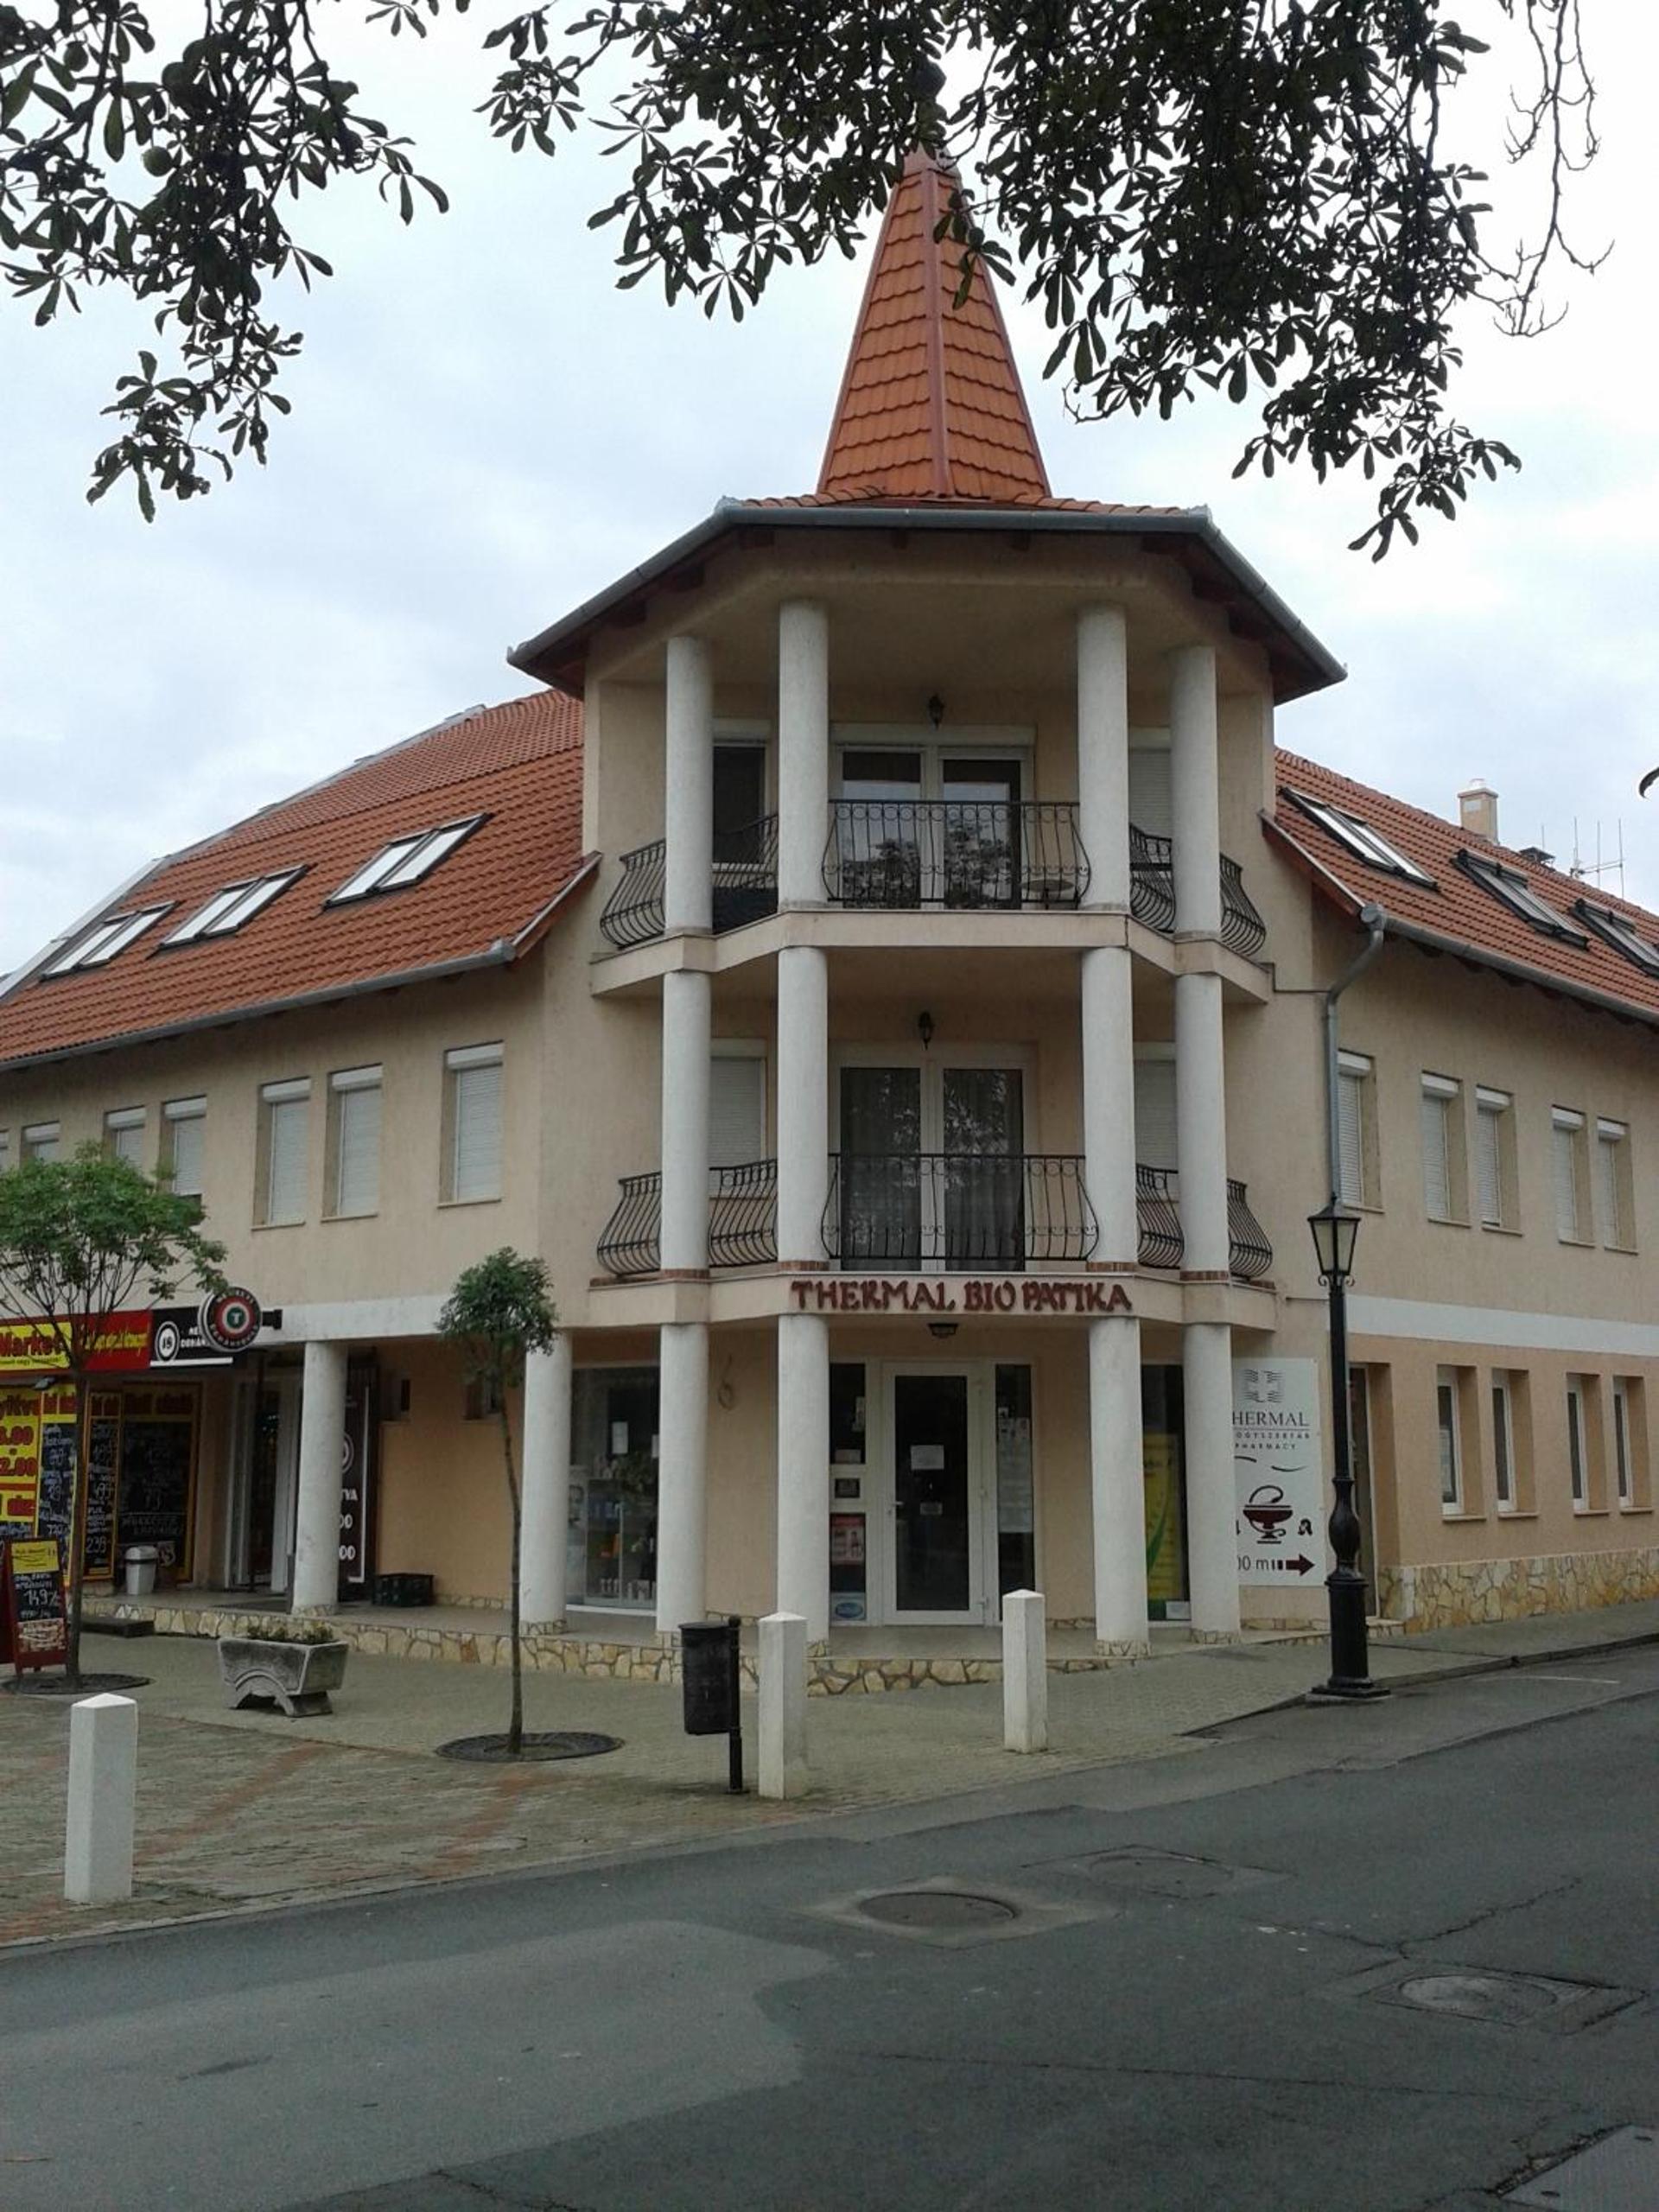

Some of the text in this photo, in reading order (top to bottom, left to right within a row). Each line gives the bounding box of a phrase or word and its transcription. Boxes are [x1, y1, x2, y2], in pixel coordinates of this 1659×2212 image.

[791, 1280, 1133, 1313] THERMAL BIO PATIKA
[1233, 1410, 1310, 1427] HERMAL
[1236, 1431, 1310, 1440] ÓGYSZERTÁR
